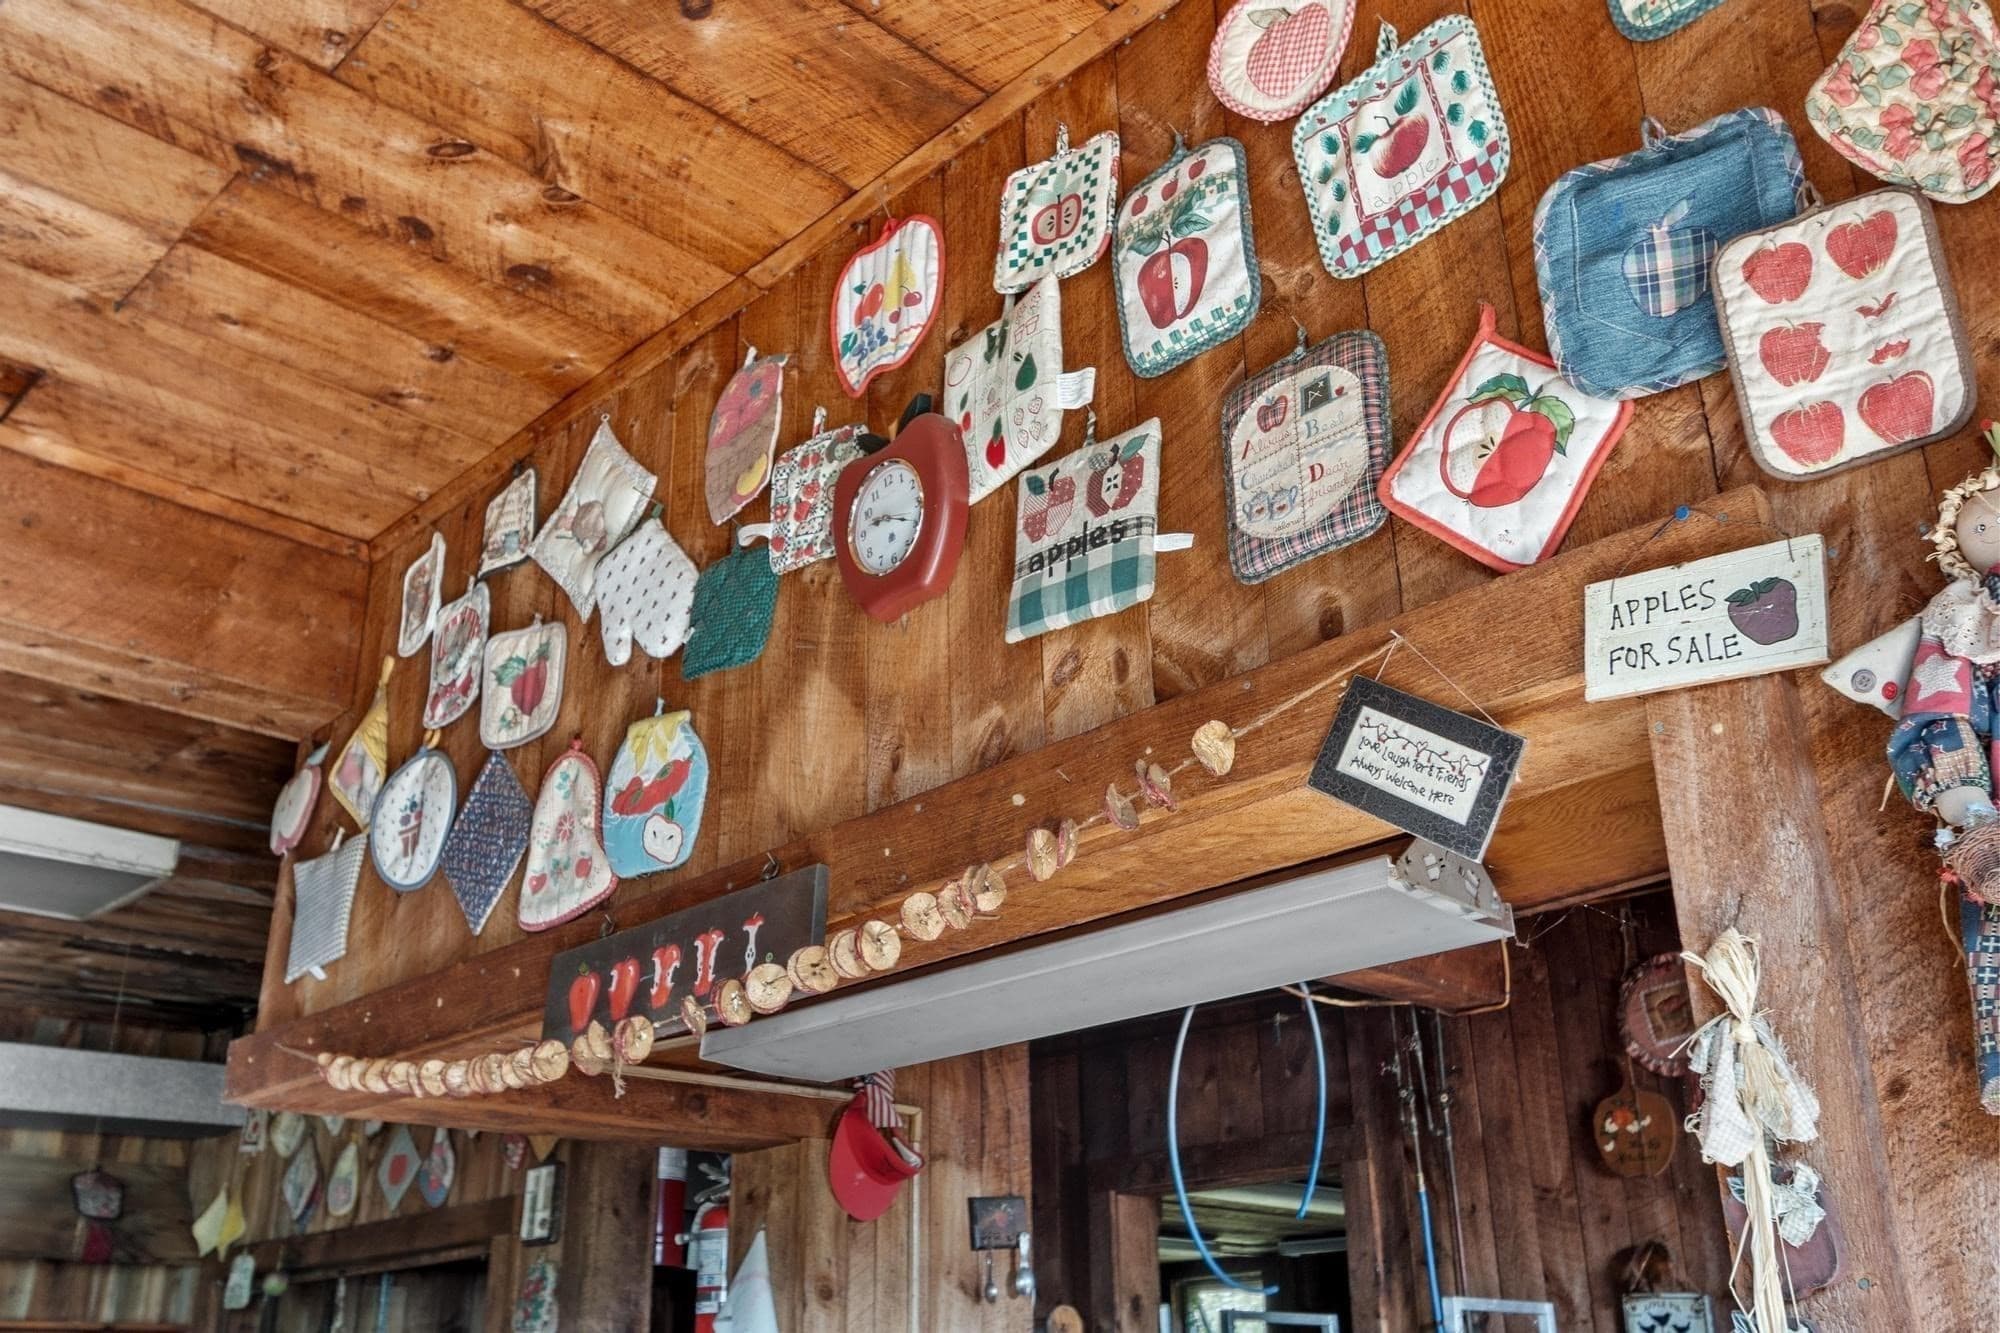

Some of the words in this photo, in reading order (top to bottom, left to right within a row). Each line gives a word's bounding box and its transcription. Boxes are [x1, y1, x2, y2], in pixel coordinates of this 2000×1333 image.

[884, 474, 894, 488] 12
[872, 490, 880, 502] 11
[864, 508, 873, 520] 10
[860, 530, 867, 541] 9
[866, 547, 873, 558] 8
[1029, 520, 1128, 577] apples
[890, 553, 898, 564] 6
[1610, 579, 1717, 630] APPLES
[1609, 642, 1660, 675] FOR
[1668, 633, 1742, 665] SALE
[1358, 735, 1381, 754] Love
[1436, 765, 1472, 793] Friends
[1351, 755, 1383, 780] Always
[1386, 770, 1426, 797] Welcome
